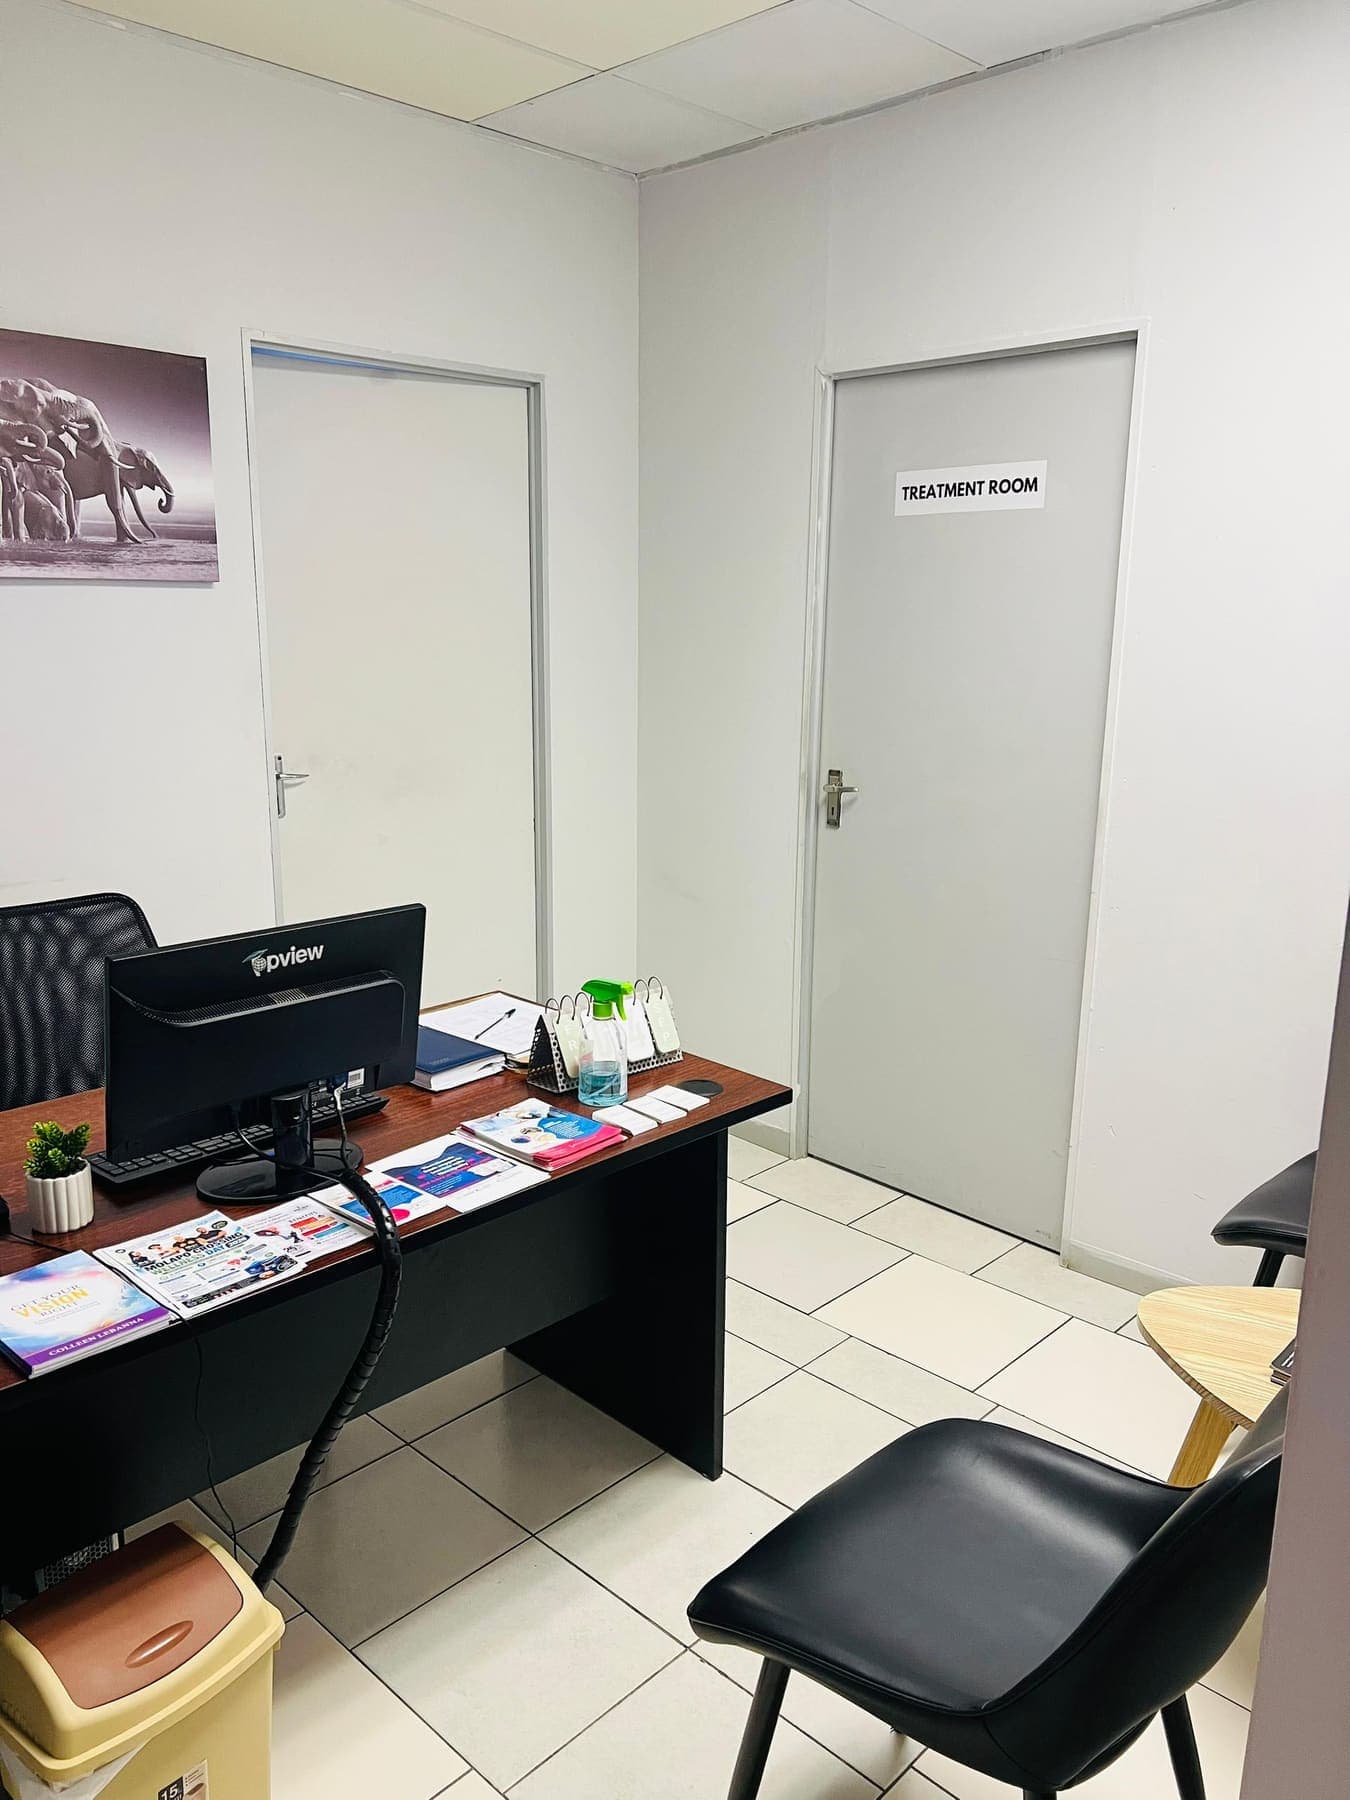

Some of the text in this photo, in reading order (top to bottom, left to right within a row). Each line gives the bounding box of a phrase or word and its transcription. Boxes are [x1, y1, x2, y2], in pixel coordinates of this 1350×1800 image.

[902, 477, 1038, 500] TREATMENT ROOM
[205, 1244, 225, 1256] DAY
[144, 1252, 192, 1271] MOLAPO
[15, 1288, 89, 1318] VISION
[48, 1336, 97, 1356] COLLEEN
[161, 1783, 178, 1800] 15
